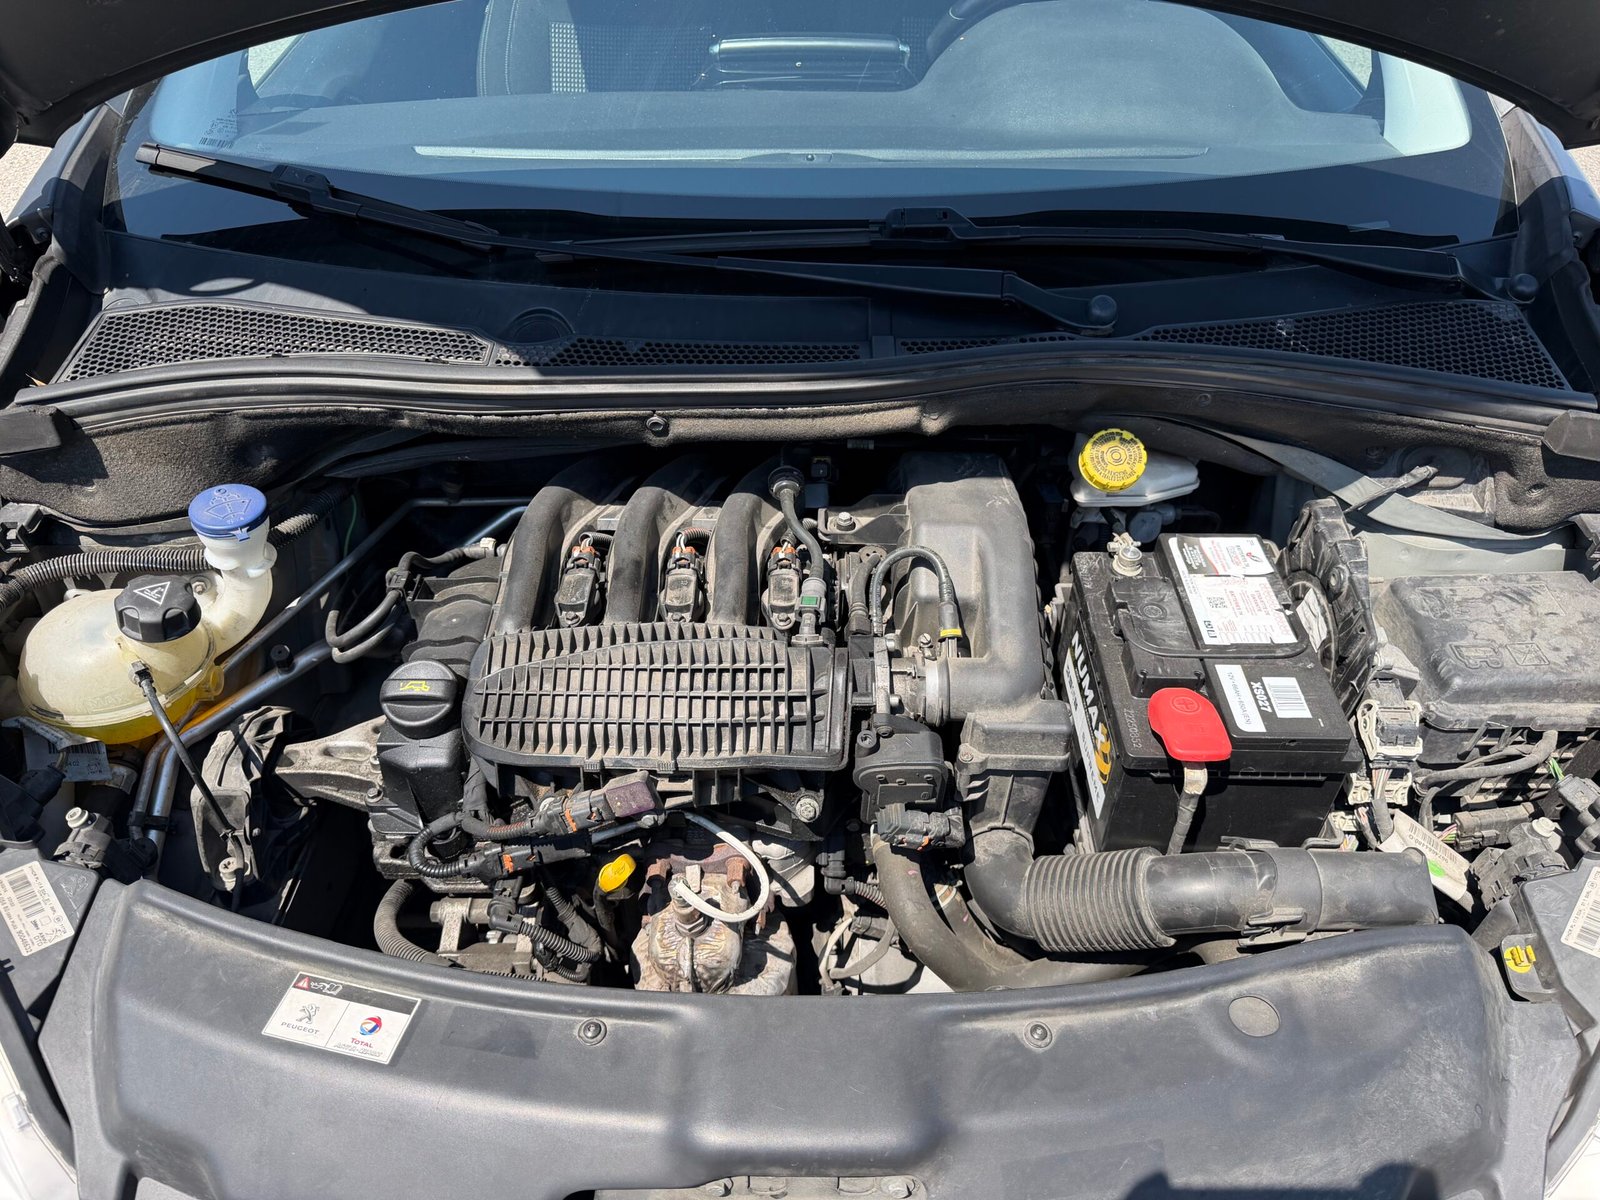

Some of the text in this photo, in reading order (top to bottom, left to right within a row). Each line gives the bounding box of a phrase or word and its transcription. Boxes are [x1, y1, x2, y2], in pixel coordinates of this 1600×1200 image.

[1071, 630, 1107, 750] NUMAX
[1250, 681, 1273, 713] XS027
[280, 1021, 320, 1035] PEUGEOT
[351, 1037, 374, 1049] TOTAL
